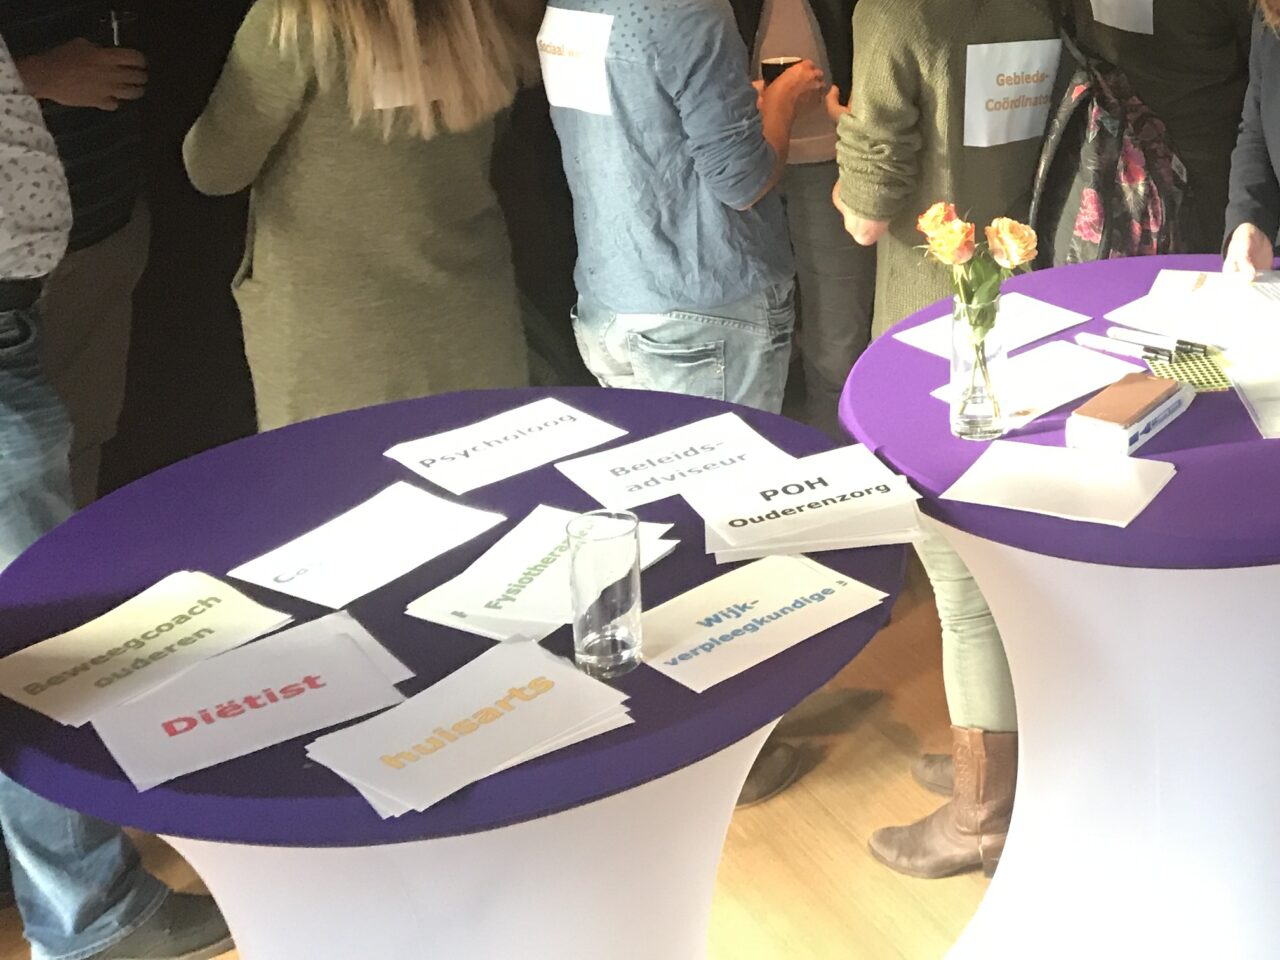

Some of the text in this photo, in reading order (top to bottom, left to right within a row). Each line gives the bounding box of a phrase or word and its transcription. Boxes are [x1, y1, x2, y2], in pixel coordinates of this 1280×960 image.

[419, 414, 577, 468] Psycholoog
[609, 441, 726, 478] Beleids-
[626, 453, 748, 493] adviseur
[759, 477, 830, 502] POH
[728, 483, 891, 528] Ouderenzorg
[664, 586, 836, 666] verpleegkundige
[696, 599, 759, 629] Wijk-
[23, 594, 222, 696] Beweegcoach
[93, 627, 215, 689] ouderen
[160, 674, 327, 738] Diëtist
[380, 675, 555, 770] huisarts
